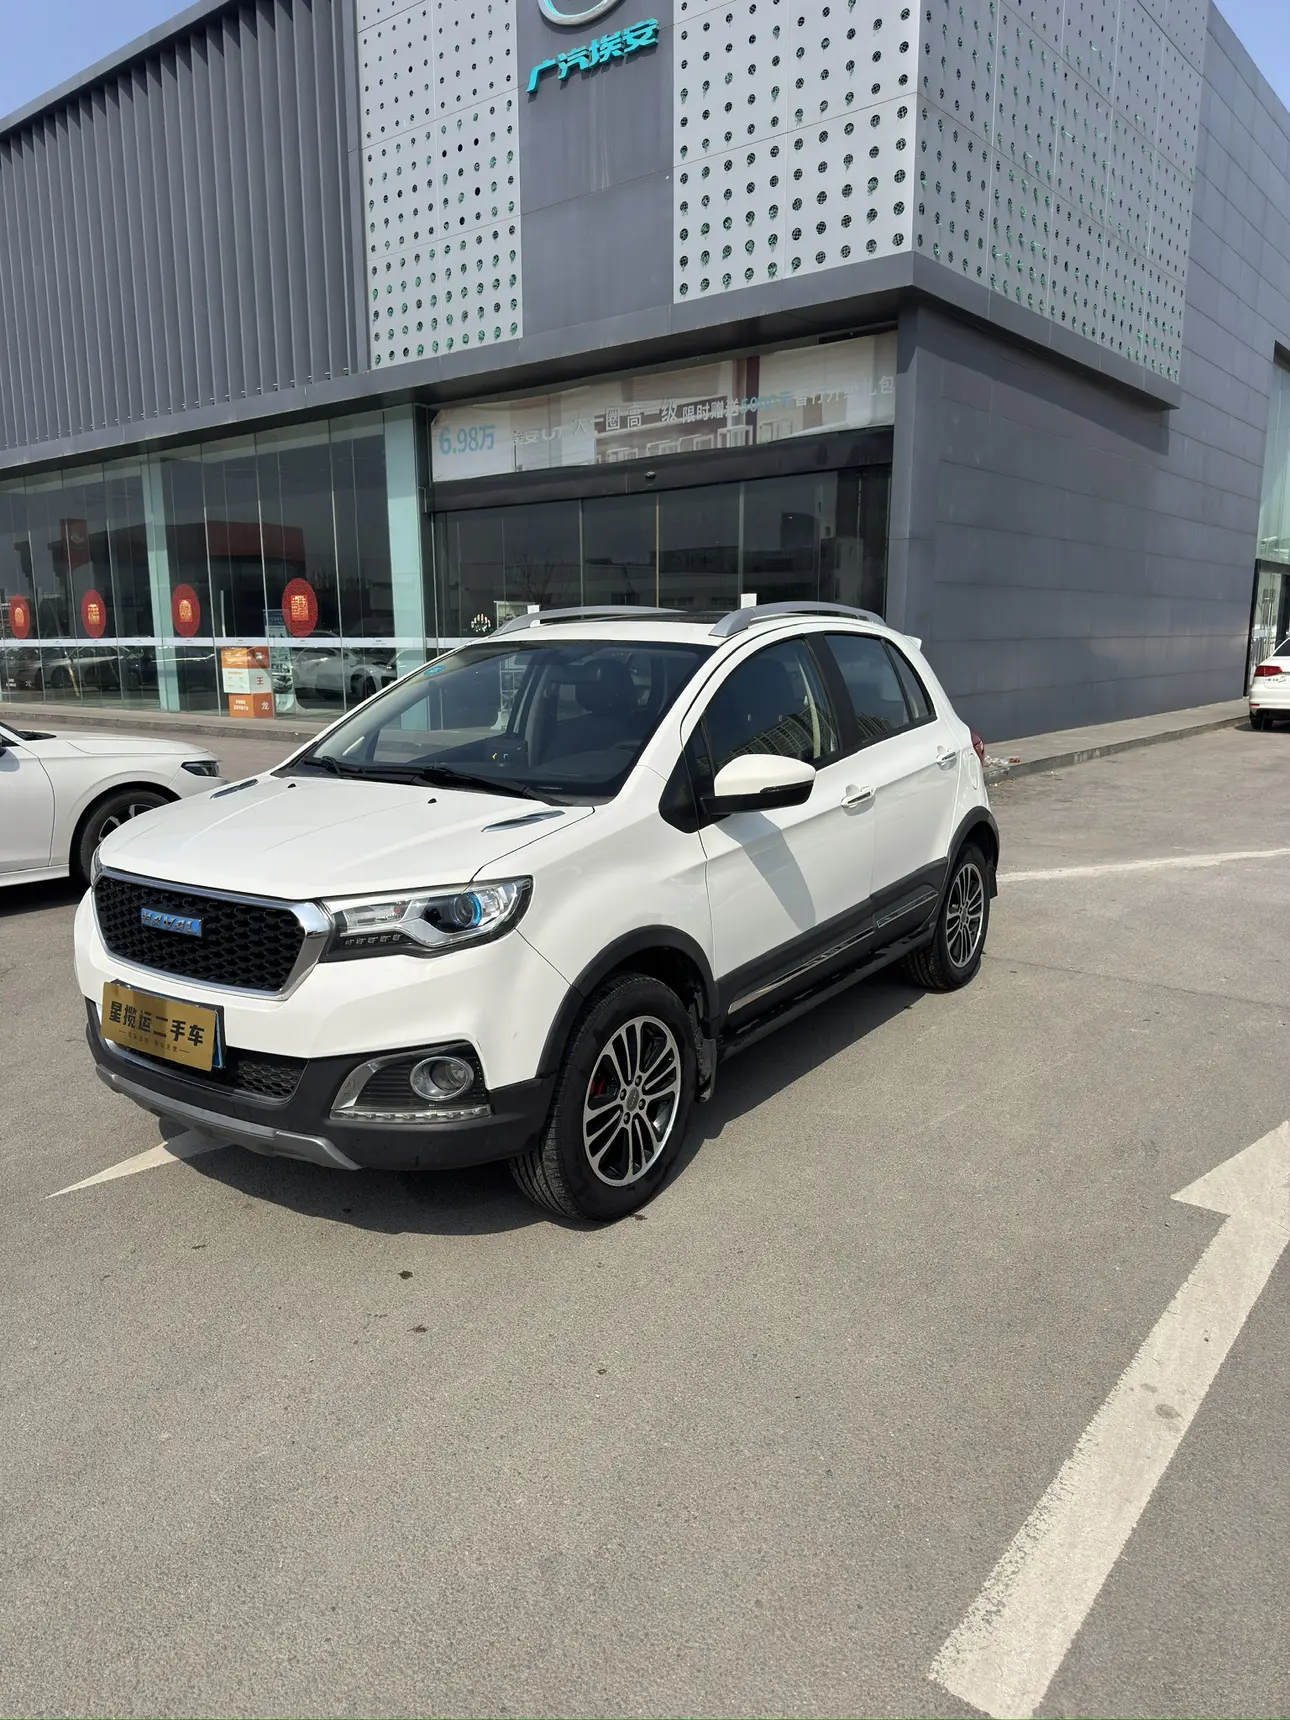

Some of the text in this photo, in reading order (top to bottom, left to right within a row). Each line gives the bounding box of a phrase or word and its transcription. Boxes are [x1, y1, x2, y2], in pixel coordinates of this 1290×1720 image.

[526, 18, 659, 93] 广汽埃安
[438, 423, 496, 455] 6.98万
[141, 911, 197, 934] HAVAL
[109, 1001, 205, 1047] 星揽运二手车
